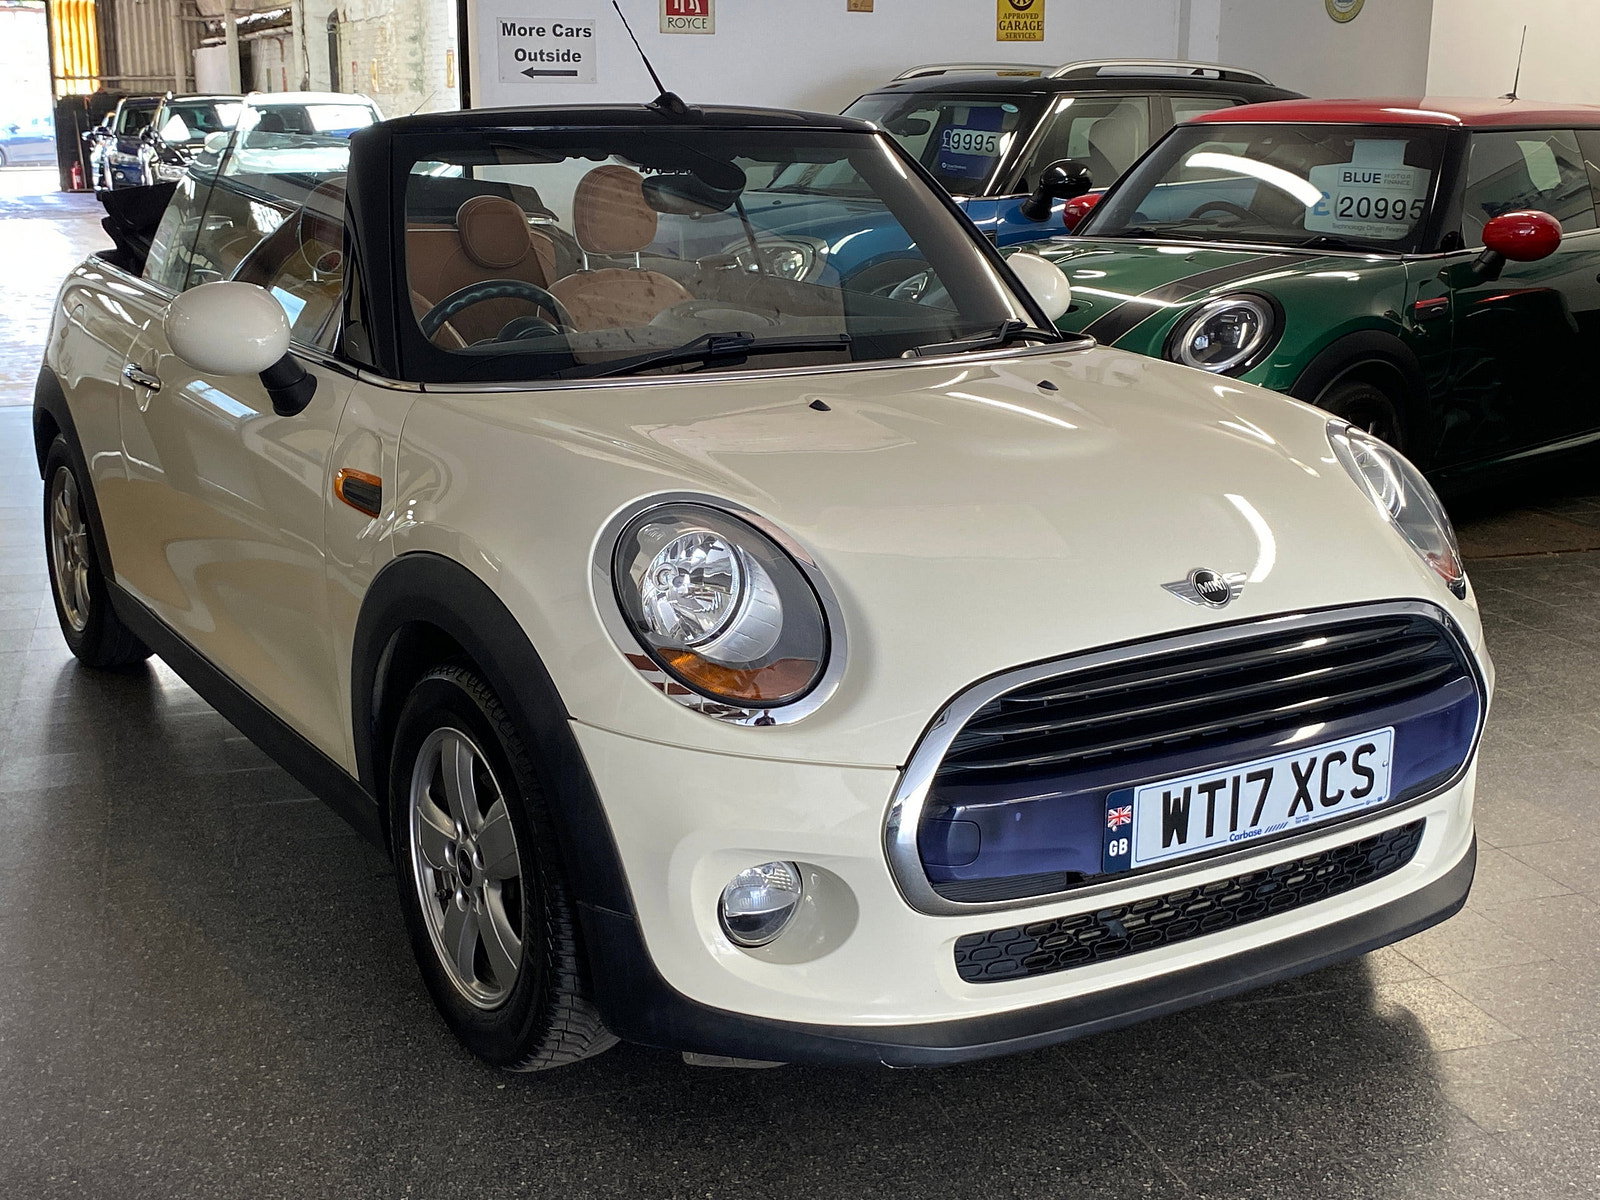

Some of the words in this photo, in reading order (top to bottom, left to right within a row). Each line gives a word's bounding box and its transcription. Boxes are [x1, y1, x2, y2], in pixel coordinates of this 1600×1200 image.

[667, 17, 708, 29] ROYCE
[1002, 12, 1040, 20] APPROVED
[501, 22, 546, 37] More
[552, 23, 593, 38] Cars
[999, 20, 1044, 31] GARAGE
[514, 48, 582, 63] Outside
[1343, 171, 1382, 184] BLUE
[1197, 580, 1226, 594] MINI
[1161, 767, 1274, 849] WT17
[1287, 742, 1377, 818] XCS
[1229, 827, 1263, 842] Carbase
[1108, 838, 1129, 857] GB
